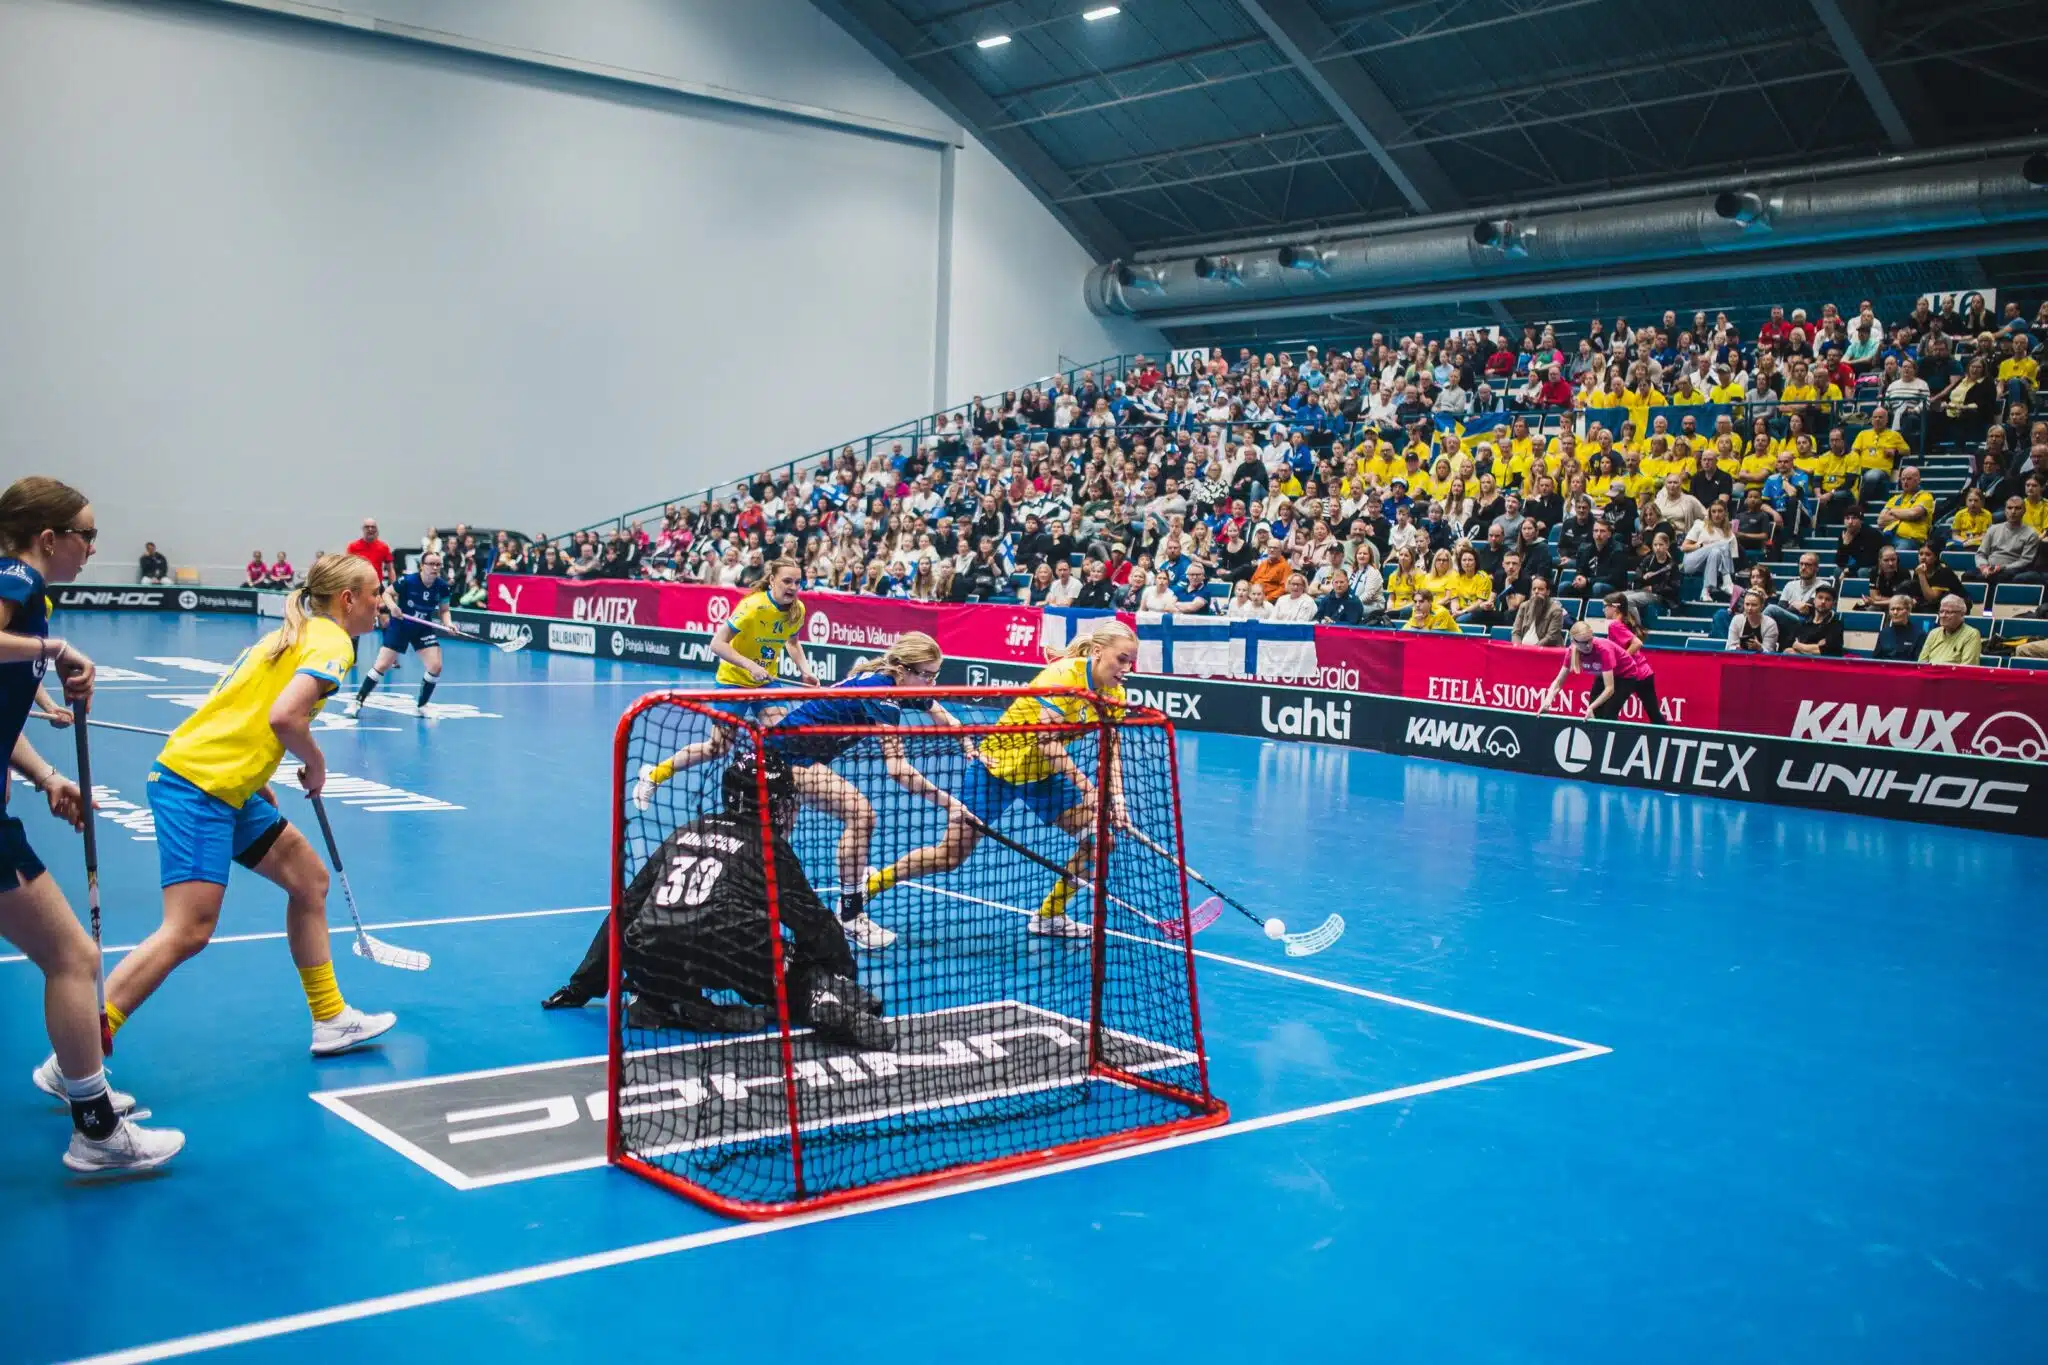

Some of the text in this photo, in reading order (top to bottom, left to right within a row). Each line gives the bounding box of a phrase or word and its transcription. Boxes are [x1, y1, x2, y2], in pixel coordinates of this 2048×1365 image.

[59, 591, 164, 606] UNIHOC
[587, 596, 637, 625] LAITEX
[625, 637, 671, 656] Pohjola Vakuutus
[831, 622, 901, 647] Pohjola Vakuut
[679, 642, 722, 662] UNI
[1261, 696, 1352, 740] Lahti
[1404, 716, 1487, 753] KAMUX
[1790, 700, 1970, 754] KAMUX
[1600, 731, 1757, 792] LAITEX
[1776, 759, 2029, 815] UNIHOC
